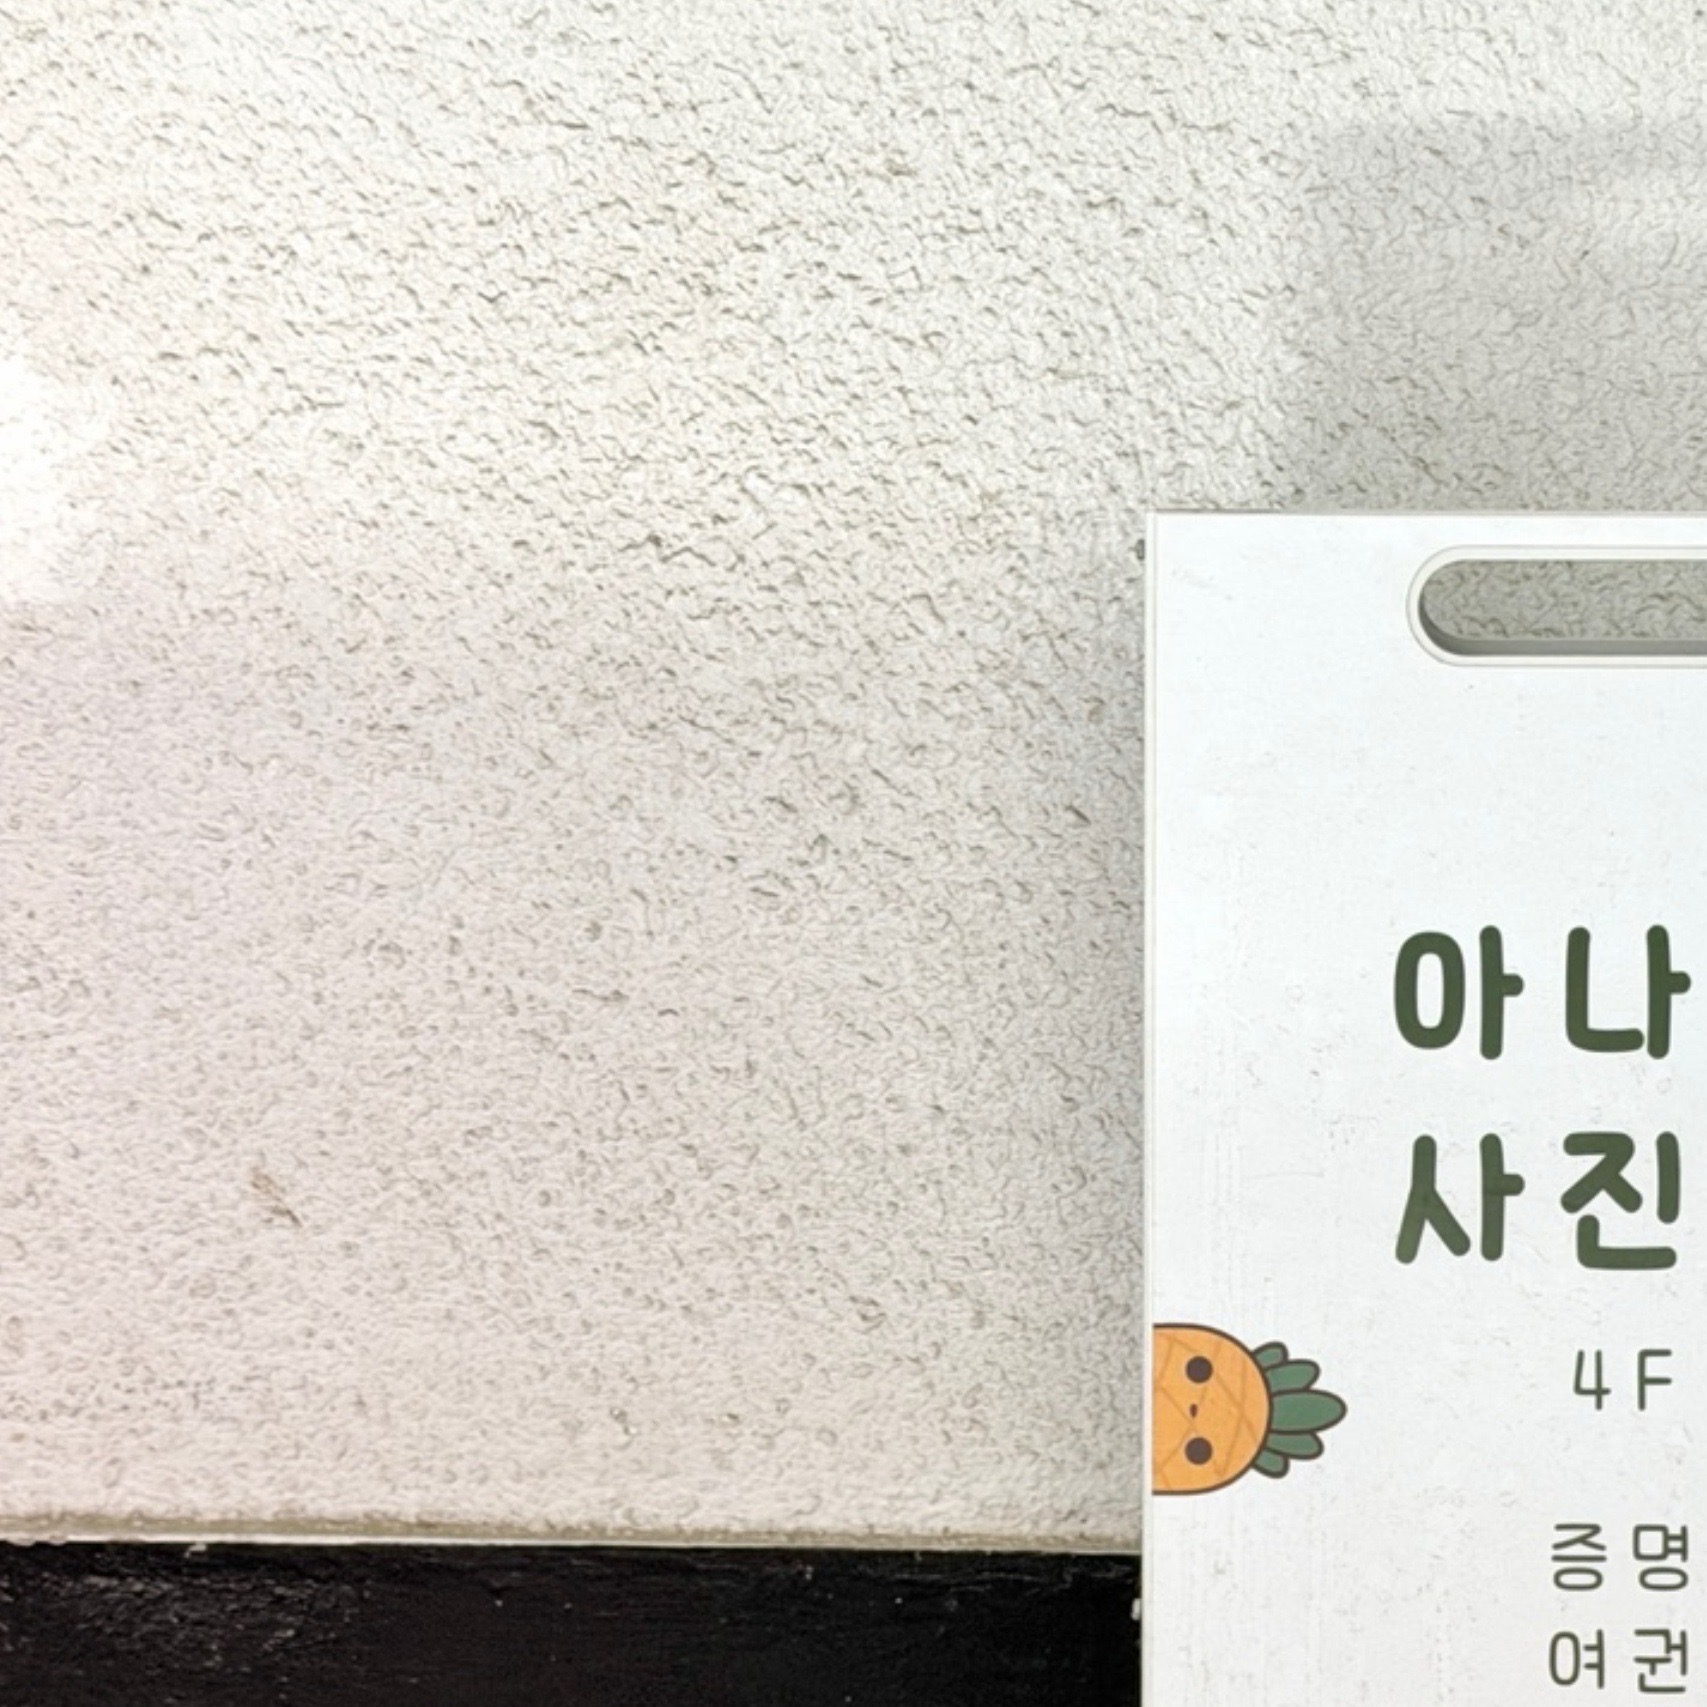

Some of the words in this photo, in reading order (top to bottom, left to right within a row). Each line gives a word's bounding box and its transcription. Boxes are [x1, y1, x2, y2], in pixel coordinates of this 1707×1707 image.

[1573, 1348, 1674, 1413] 4F
[1551, 1523, 1691, 1594] 증명
[1549, 1628, 1690, 1696] 여권
